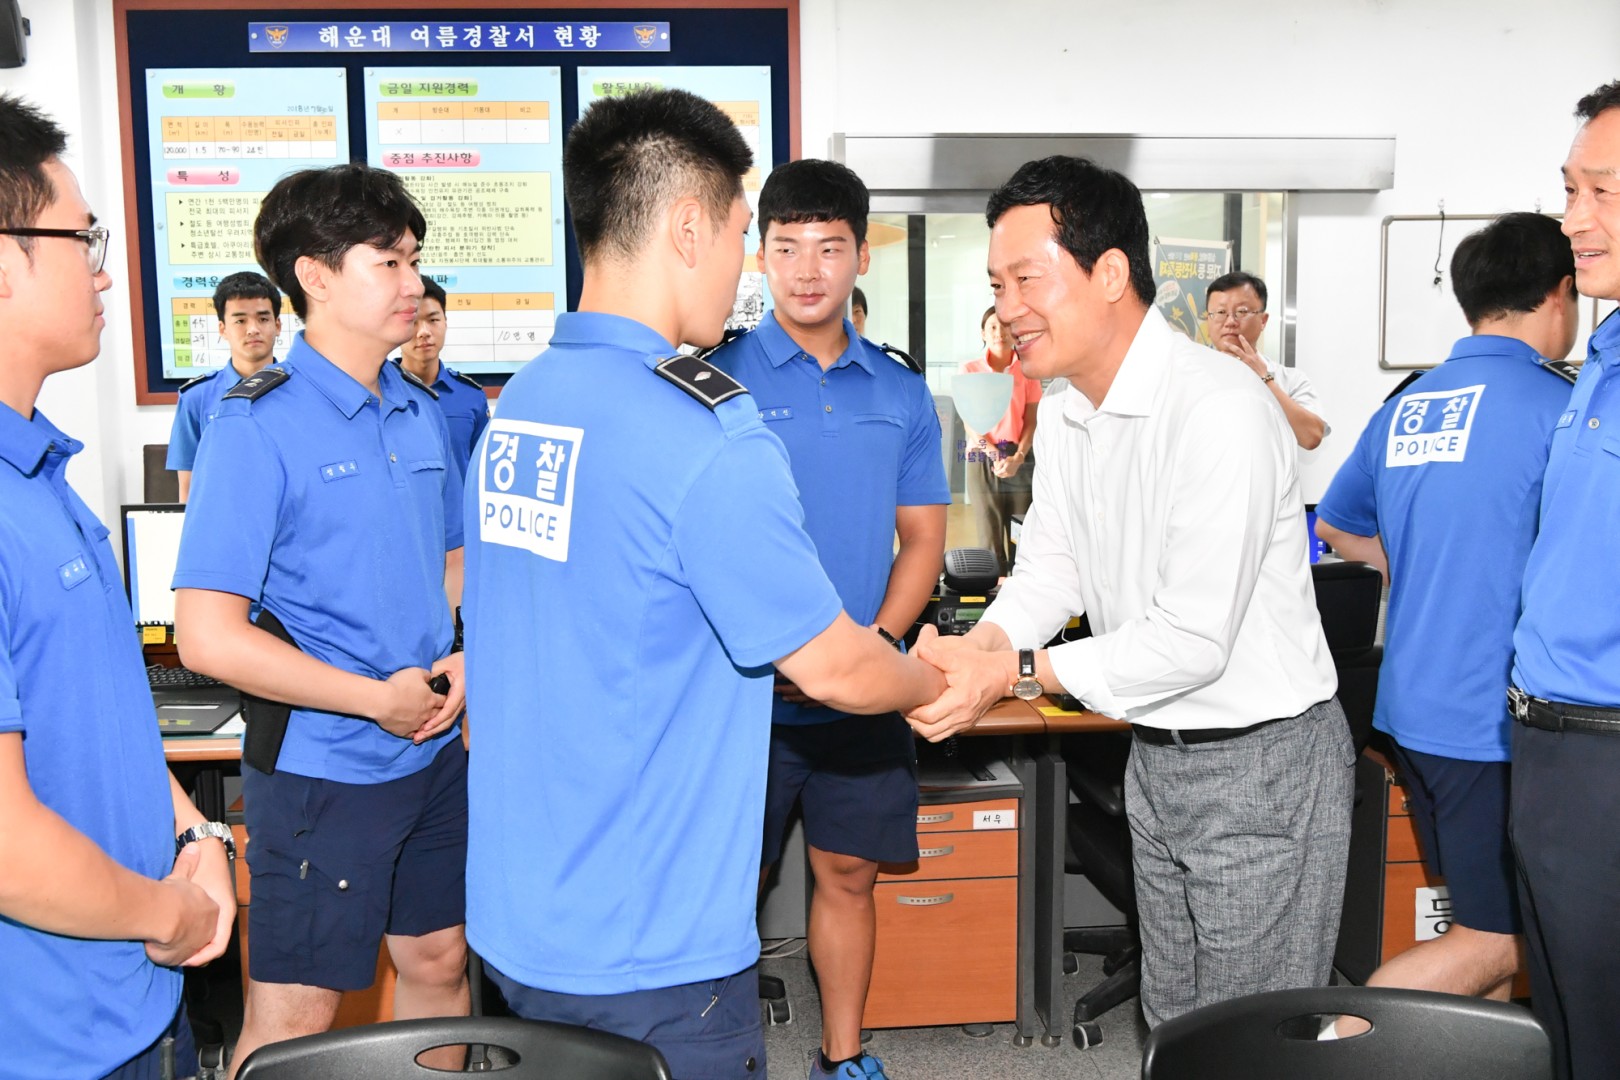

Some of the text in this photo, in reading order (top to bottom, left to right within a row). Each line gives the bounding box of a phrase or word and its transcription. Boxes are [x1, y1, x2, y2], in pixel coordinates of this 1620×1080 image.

[318, 25, 602, 49] 해운대 여름경찰서 현황
[172, 84, 226, 97] 개 황
[387, 82, 470, 95] 금일 지원경력
[390, 153, 473, 164] 중점 추진사항
[176, 170, 230, 182] 특 성
[223, 241, 254, 249] 아쿠아리
[193, 334, 205, 347] 29
[1402, 396, 1469, 435] 경찰
[1395, 436, 1459, 457] POLICE
[490, 433, 567, 502] 경찰
[484, 502, 558, 541] POLICE
